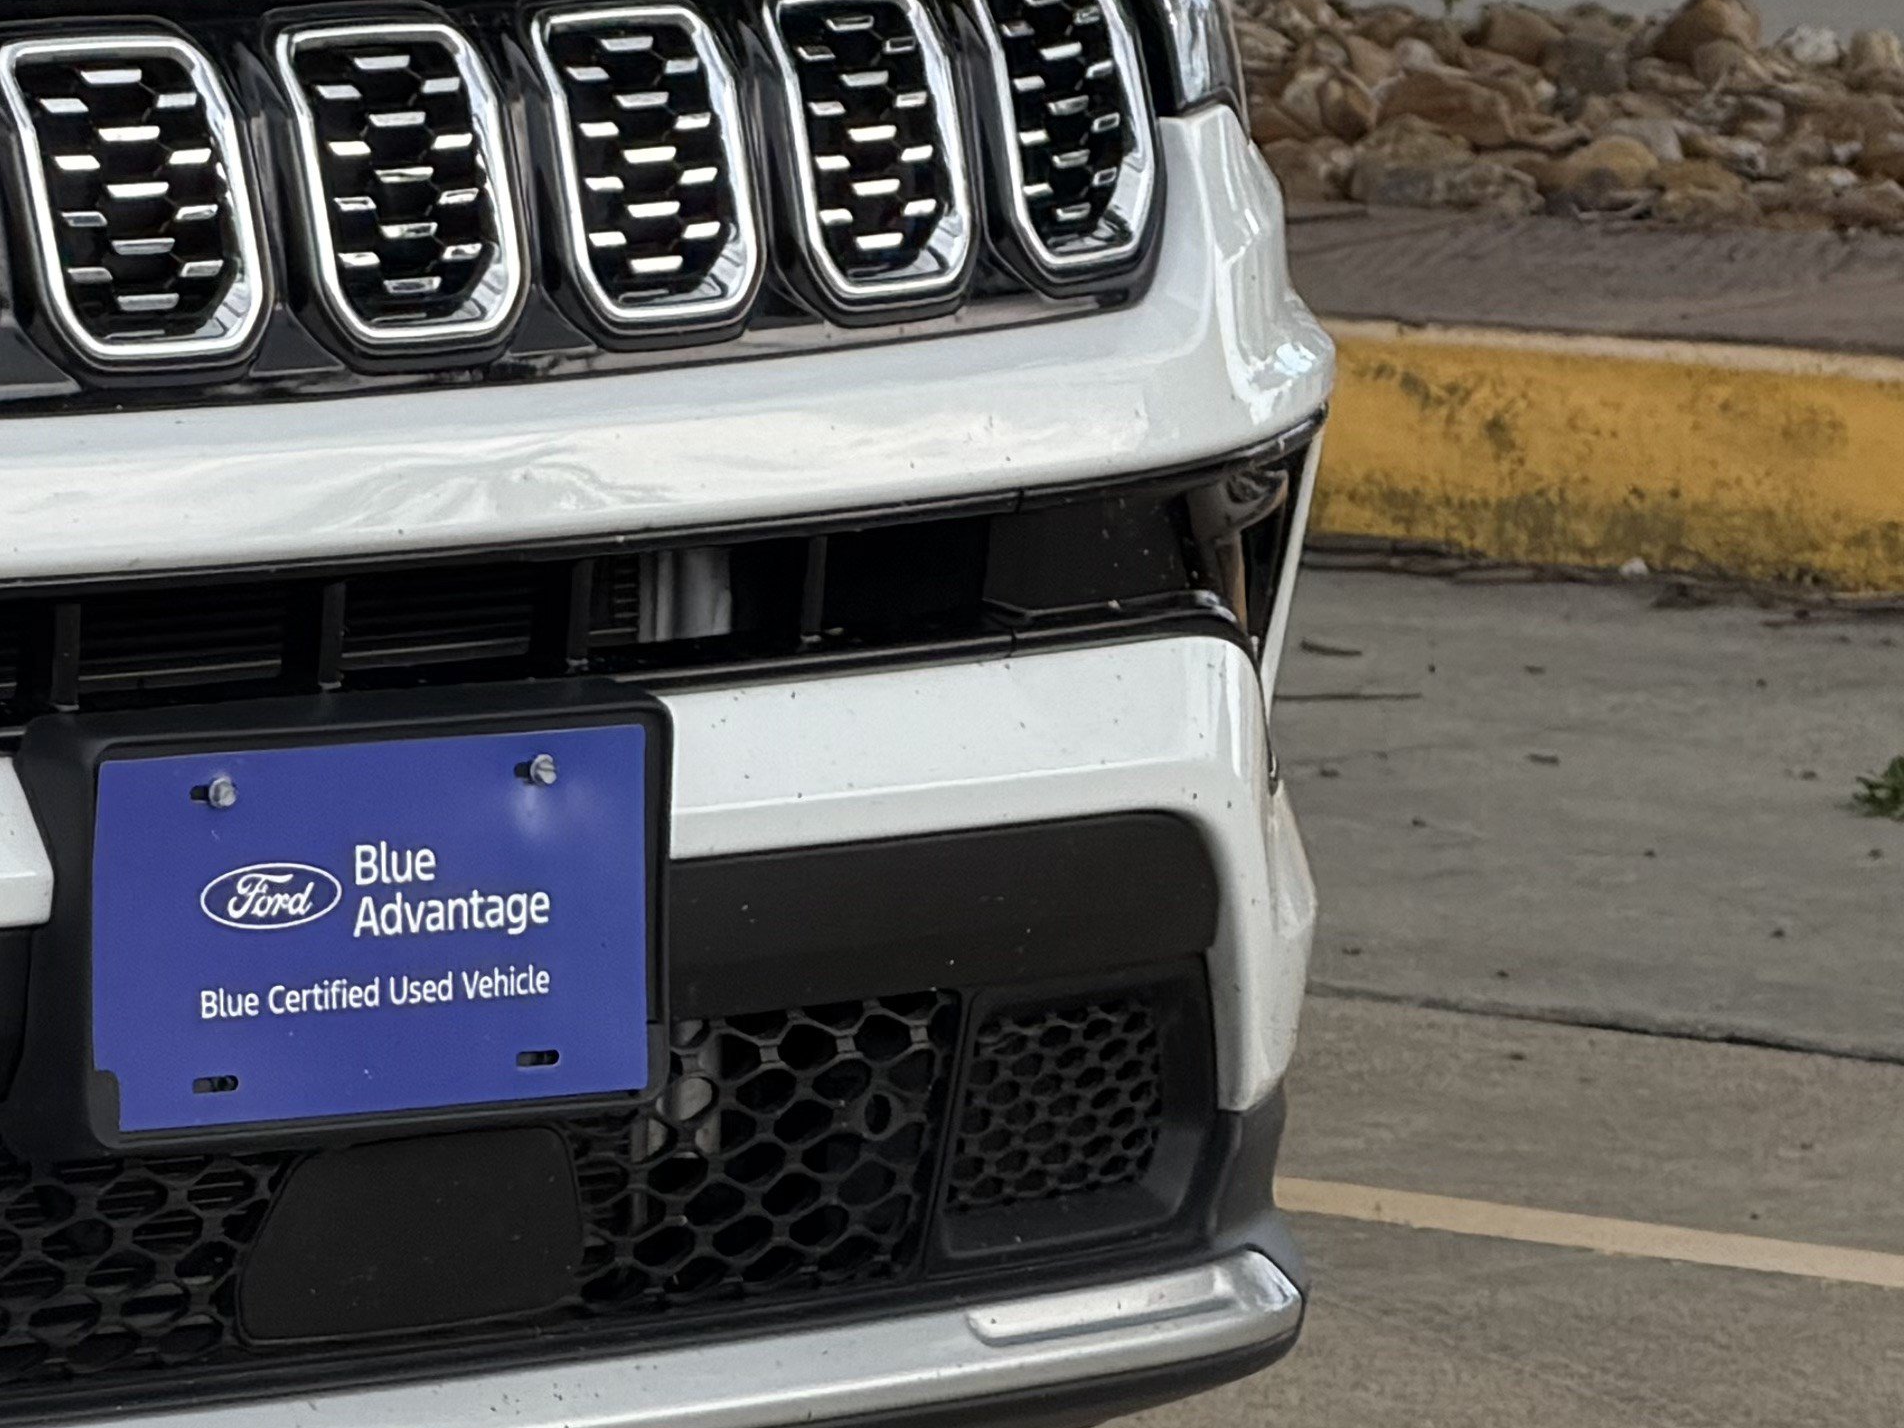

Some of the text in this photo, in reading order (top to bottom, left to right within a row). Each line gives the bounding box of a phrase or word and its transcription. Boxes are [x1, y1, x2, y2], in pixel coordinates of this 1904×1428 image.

[354, 841, 436, 886] Blue
[227, 872, 314, 920] Ford
[353, 888, 551, 938] Advantage
[200, 964, 551, 1019] Blue Certified Used Vehicle
